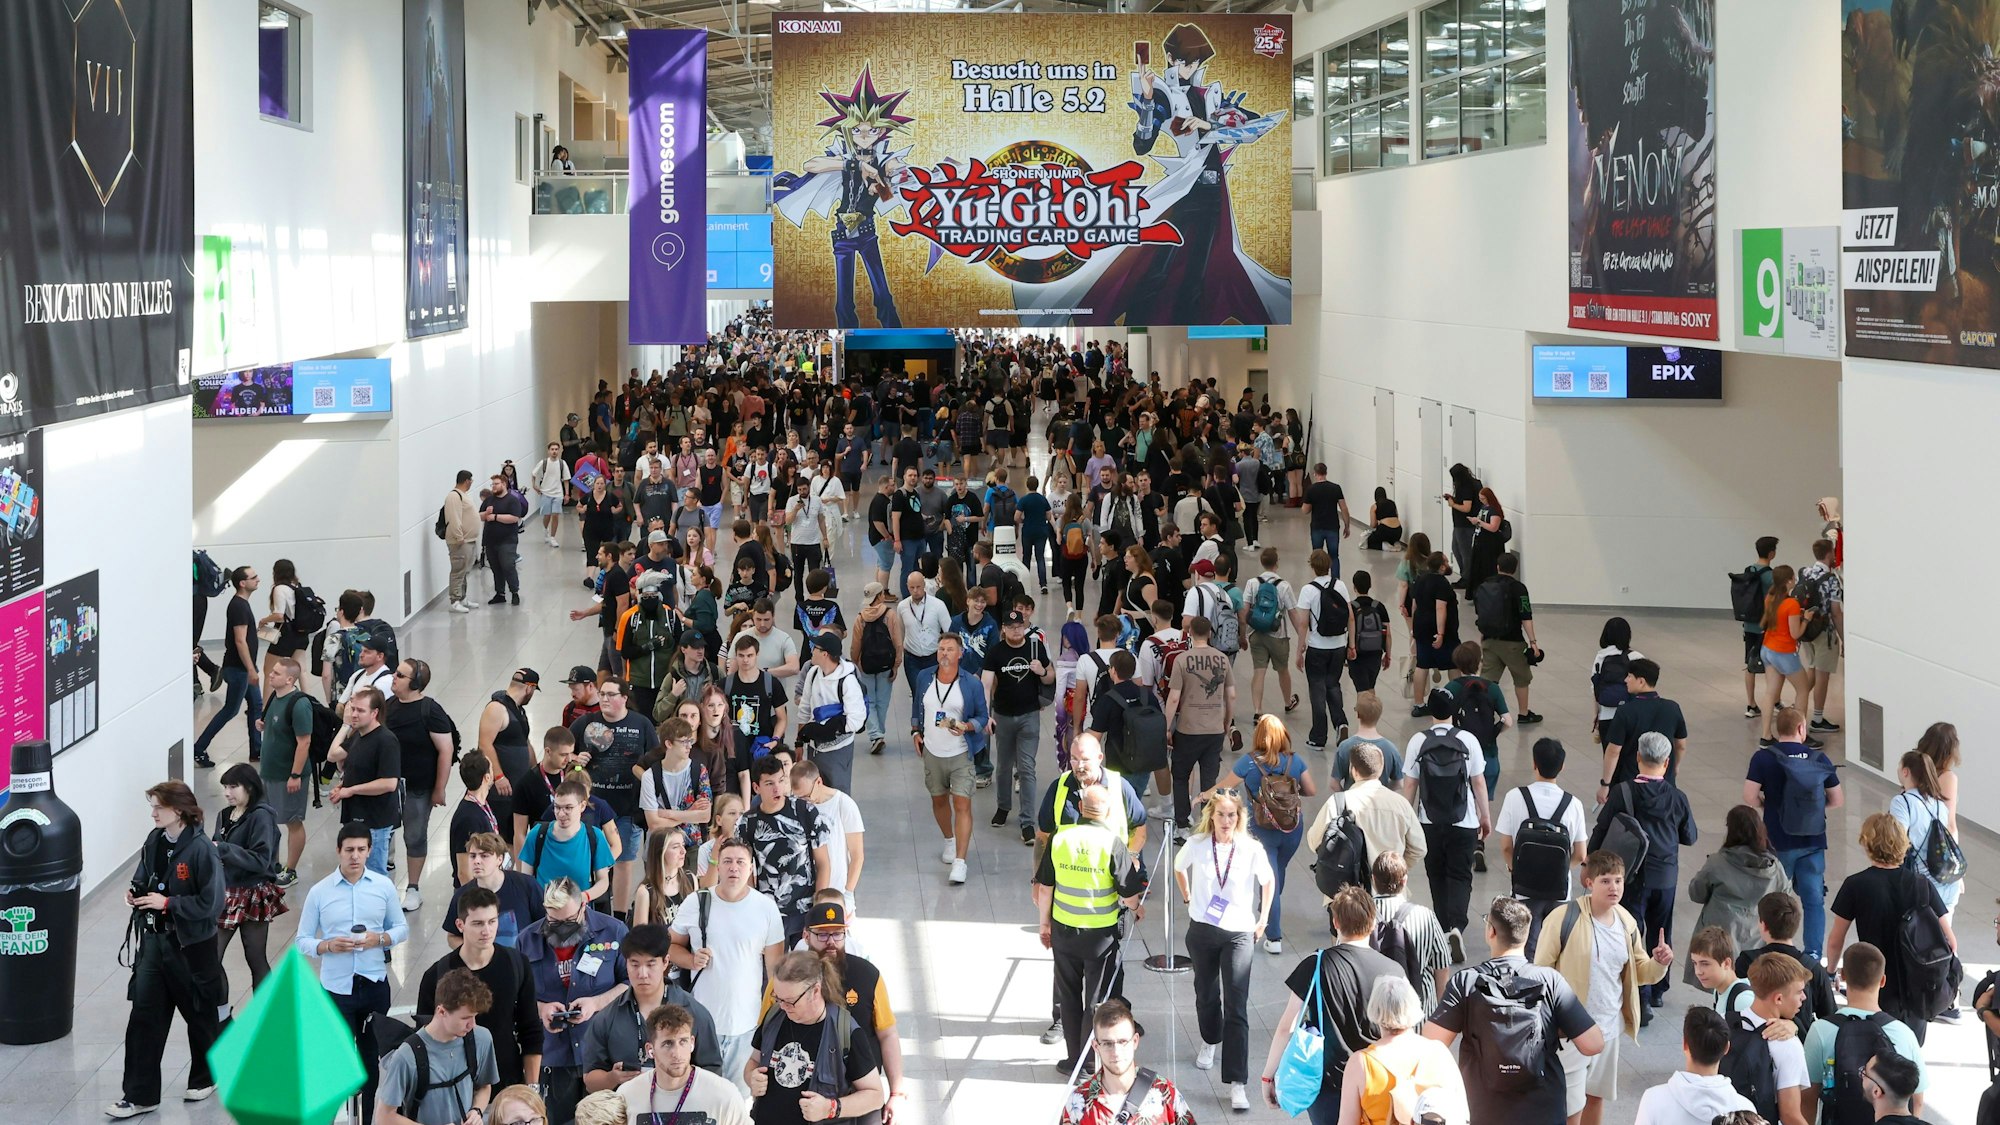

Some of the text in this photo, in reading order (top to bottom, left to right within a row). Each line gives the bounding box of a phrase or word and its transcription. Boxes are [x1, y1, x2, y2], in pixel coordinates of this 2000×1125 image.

[778, 20, 841, 34] KONAMI
[951, 59, 1117, 80] Besucht uns in
[86, 60, 122, 116] VII
[963, 83, 1107, 113] Halle 5.2
[659, 102, 679, 224] gamescom
[1595, 121, 1684, 212] VENOM
[992, 168, 1079, 180] SHONEN JUMP
[929, 184, 1148, 228] Yu-Gi-Oh!
[937, 228, 1140, 243] TRADING CARD GAME
[1855, 214, 1894, 240] JETZT
[1855, 258, 1935, 284] ANSPIELEN!
[24, 279, 173, 324] BESUCHT UNS IN HALLE 6
[1757, 257, 1781, 338] 9
[1680, 312, 1711, 328] SONY
[1959, 331, 1996, 348] CAPCOM
[1652, 364, 1695, 381] EPIX
[215, 405, 288, 416] IN JEDER HALLE
[1001, 664, 1030, 673] gamesco
[1186, 655, 1226, 671] CHASE
[25, 931, 47, 940] DEIN
[0, 939, 47, 954] FAND
